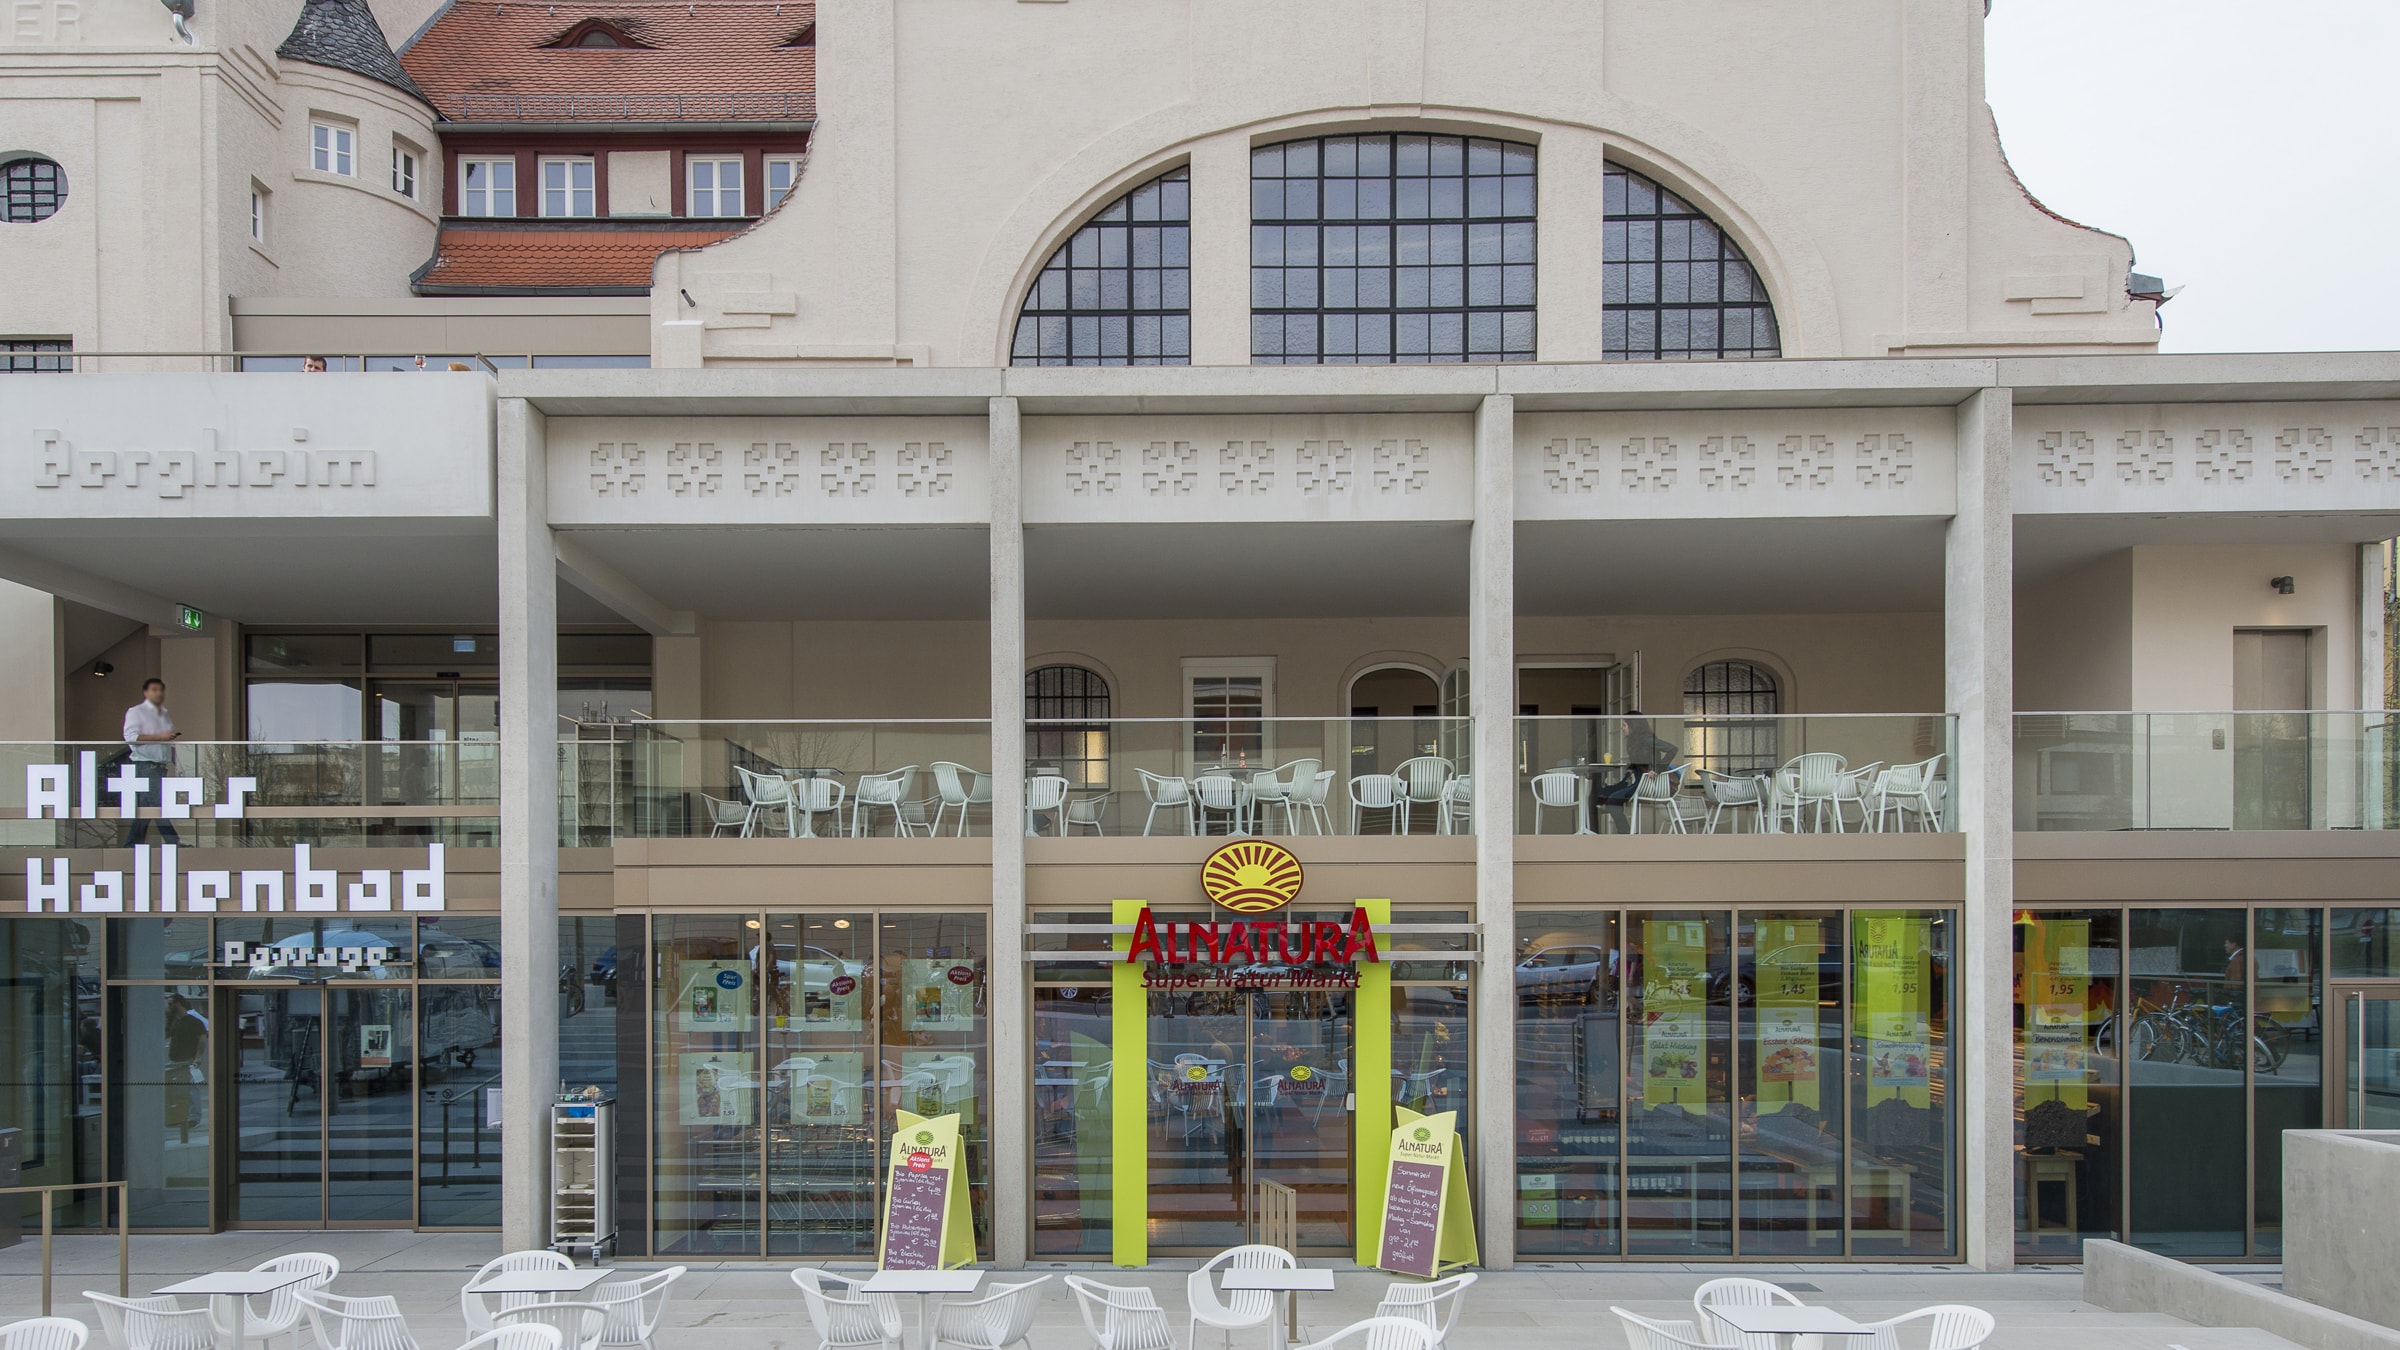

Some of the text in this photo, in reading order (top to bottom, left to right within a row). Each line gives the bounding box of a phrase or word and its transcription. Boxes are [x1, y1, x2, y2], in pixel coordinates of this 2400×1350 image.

[11, 0, 85, 41] ER
[33, 428, 376, 498] Bergheim
[26, 750, 257, 819] Altes
[26, 842, 445, 912] Hallenbad
[1126, 907, 1379, 963] ALNATURA
[224, 941, 388, 972] Passage
[1140, 968, 1363, 992] Super Natur Markt
[1781, 984, 1806, 996] 1,45
[1893, 982, 1918, 994] 1,95
[2049, 984, 2075, 996] 1,95
[1277, 1079, 1325, 1090] ALNATURA
[900, 1142, 946, 1157] ALNATURA
[1399, 1138, 1443, 1154] ALNATURA
